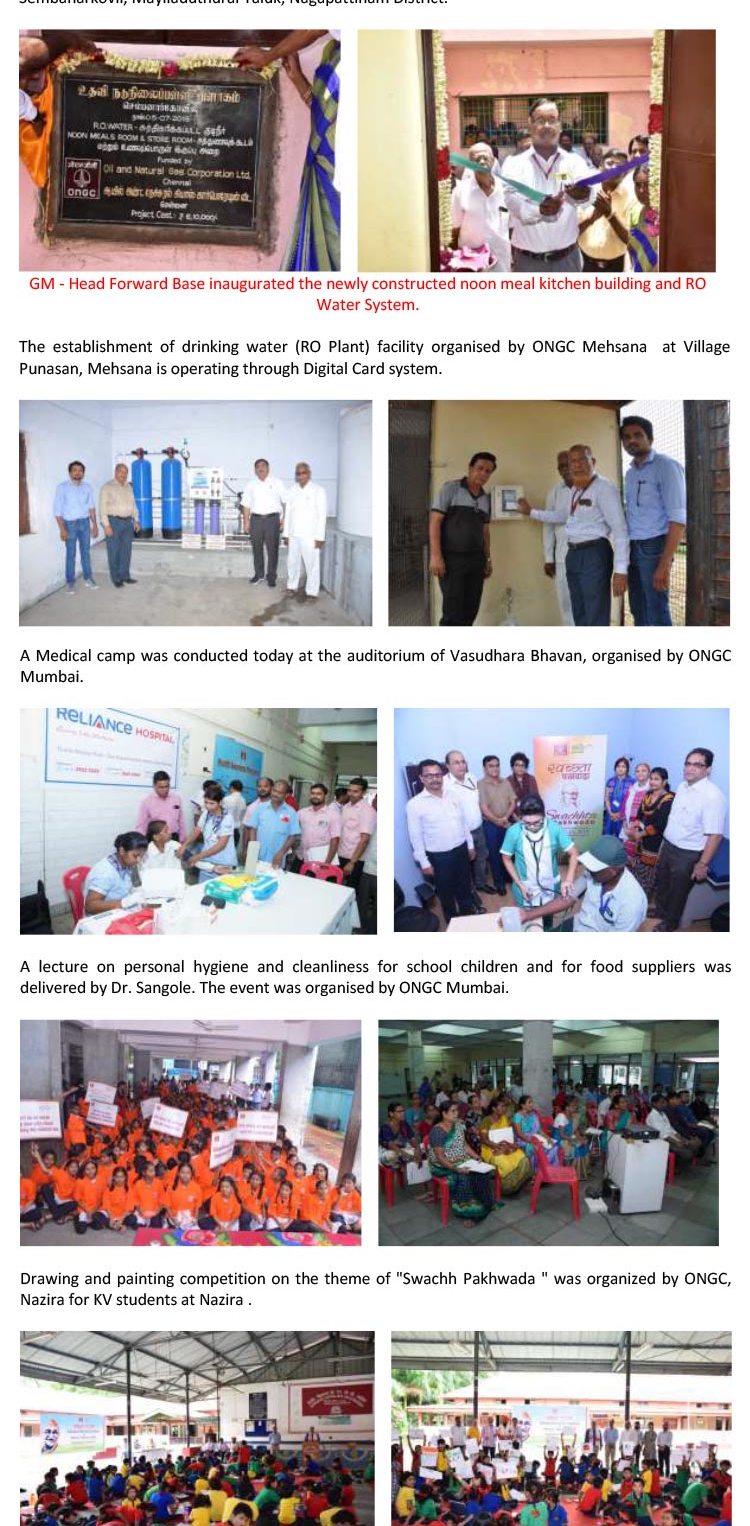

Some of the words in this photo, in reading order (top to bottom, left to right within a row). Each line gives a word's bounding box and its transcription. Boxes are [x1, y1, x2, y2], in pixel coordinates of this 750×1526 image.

[67, 132, 88, 140] NOON
[90, 133, 116, 141] MEALS
[118, 134, 139, 142] ROOM
[147, 135, 169, 143] STORE
[157, 156, 182, 164] Funded
[184, 158, 193, 166] by
[103, 165, 114, 173] Oil
[116, 165, 132, 174] and
[134, 165, 165, 175] Natural
[168, 168, 184, 176] Gas
[187, 168, 235, 179] Corporation
[162, 178, 192, 186] Chennai
[131, 210, 155, 220] Project
[135, 727, 175, 745] HOSPITAL
